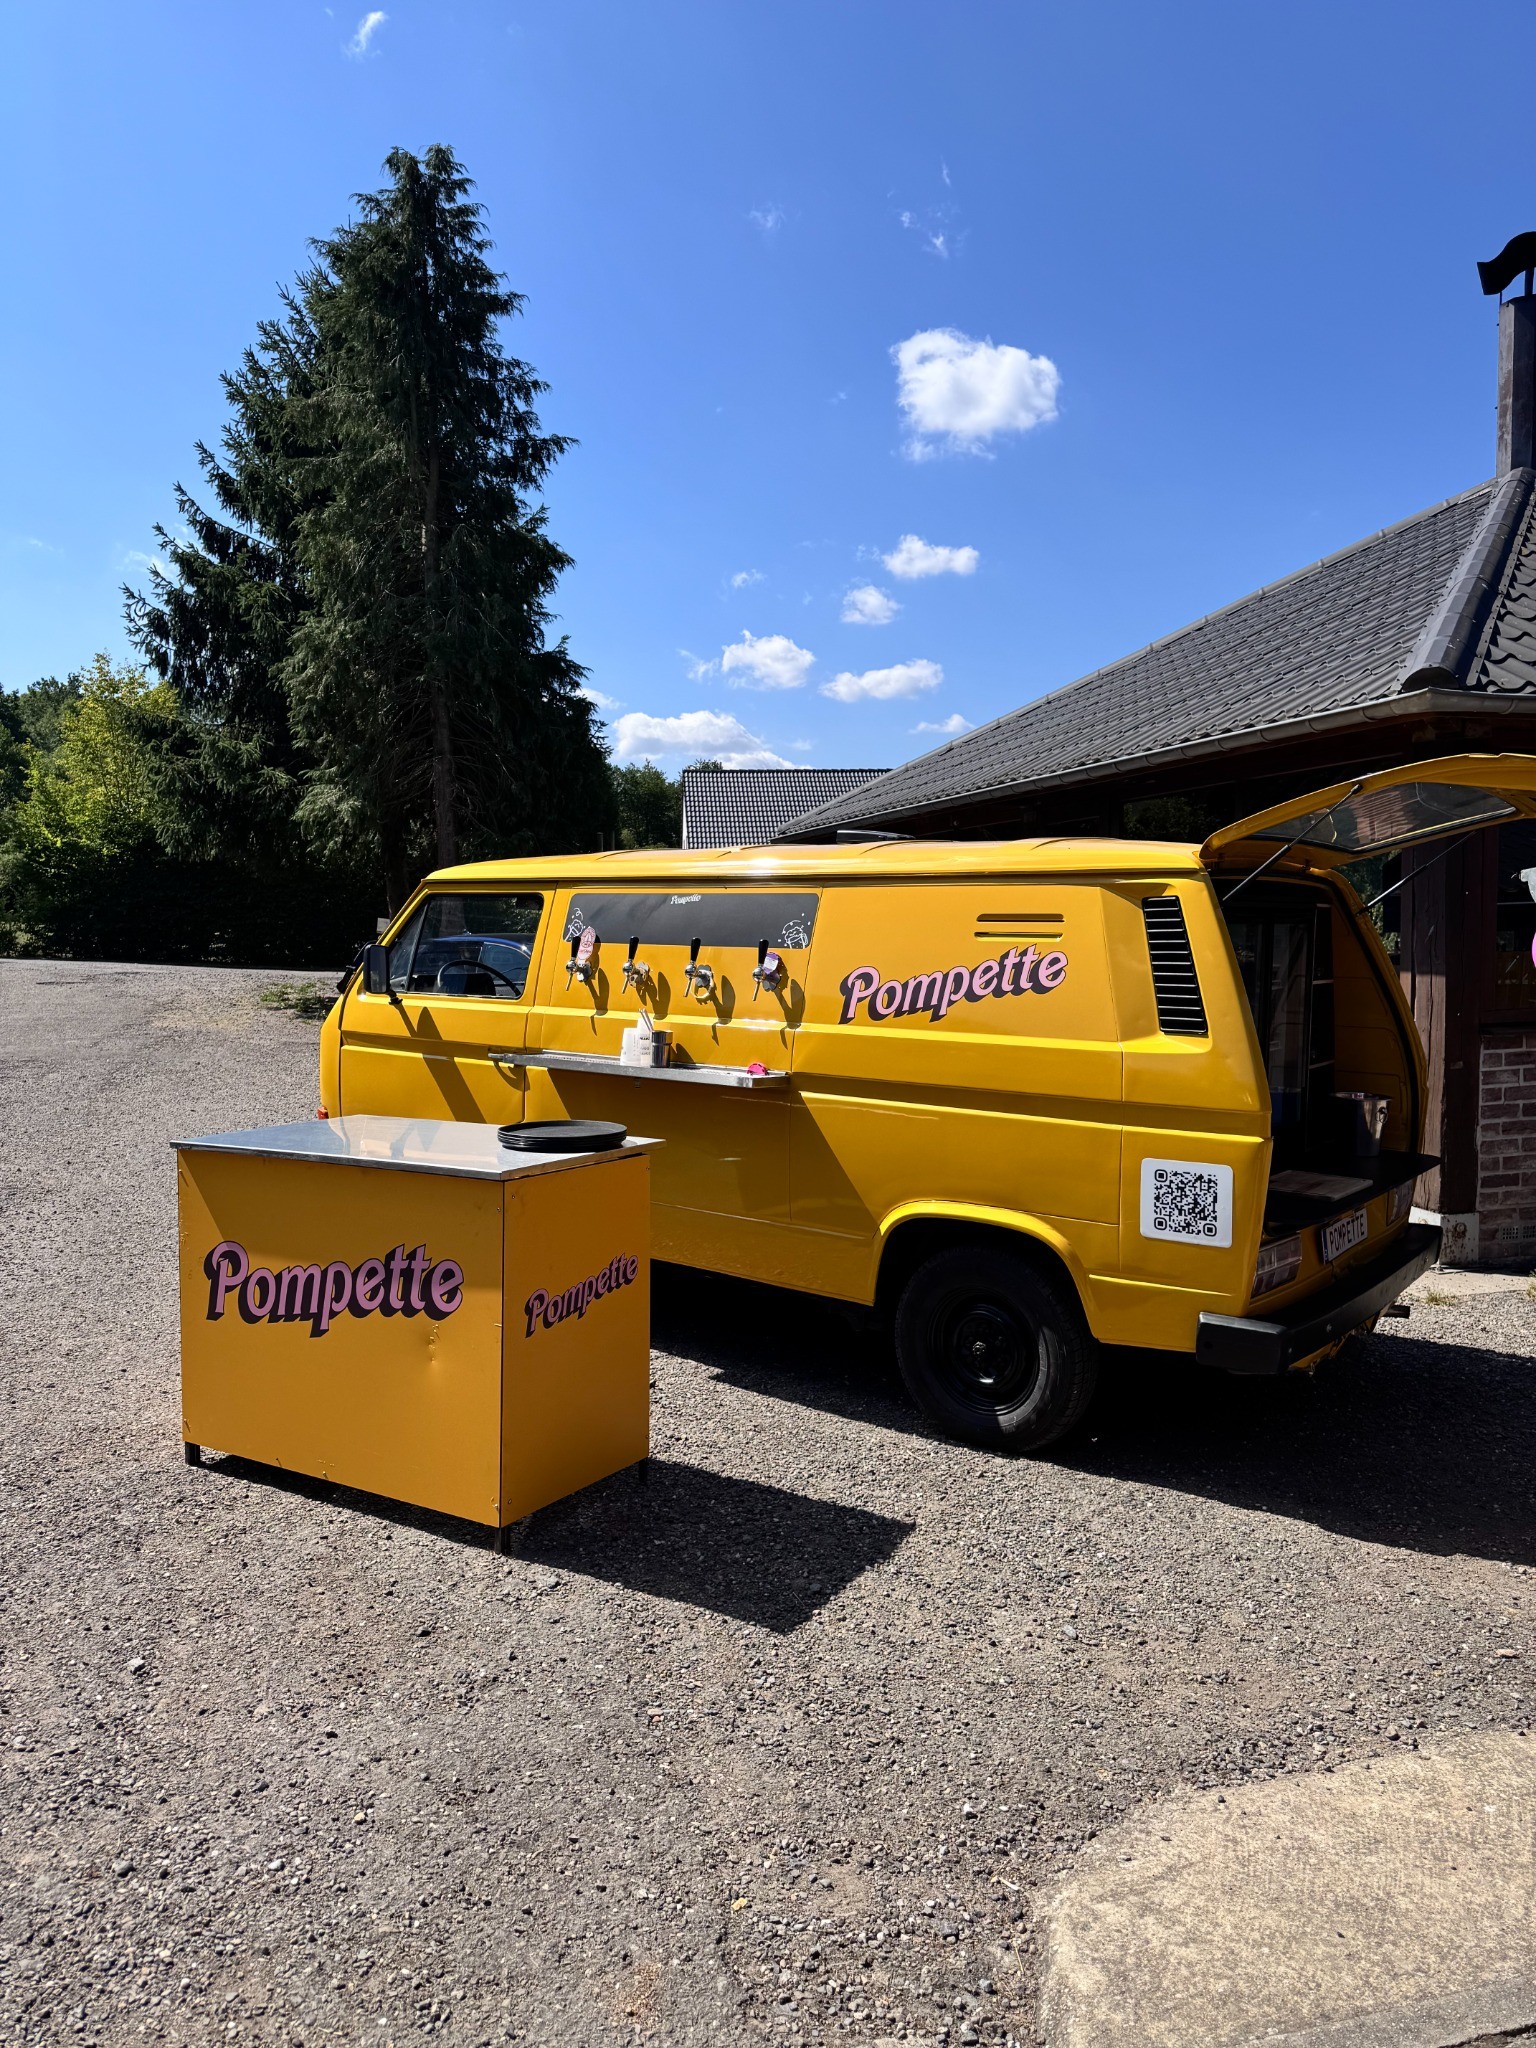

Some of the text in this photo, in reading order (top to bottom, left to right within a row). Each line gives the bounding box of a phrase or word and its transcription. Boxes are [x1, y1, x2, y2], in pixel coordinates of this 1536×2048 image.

[838, 943, 1068, 1025] Pompette
[1329, 1212, 1365, 1255] POMPETTE
[204, 1241, 464, 1338] Pompette
[525, 1252, 639, 1338] Pompette
